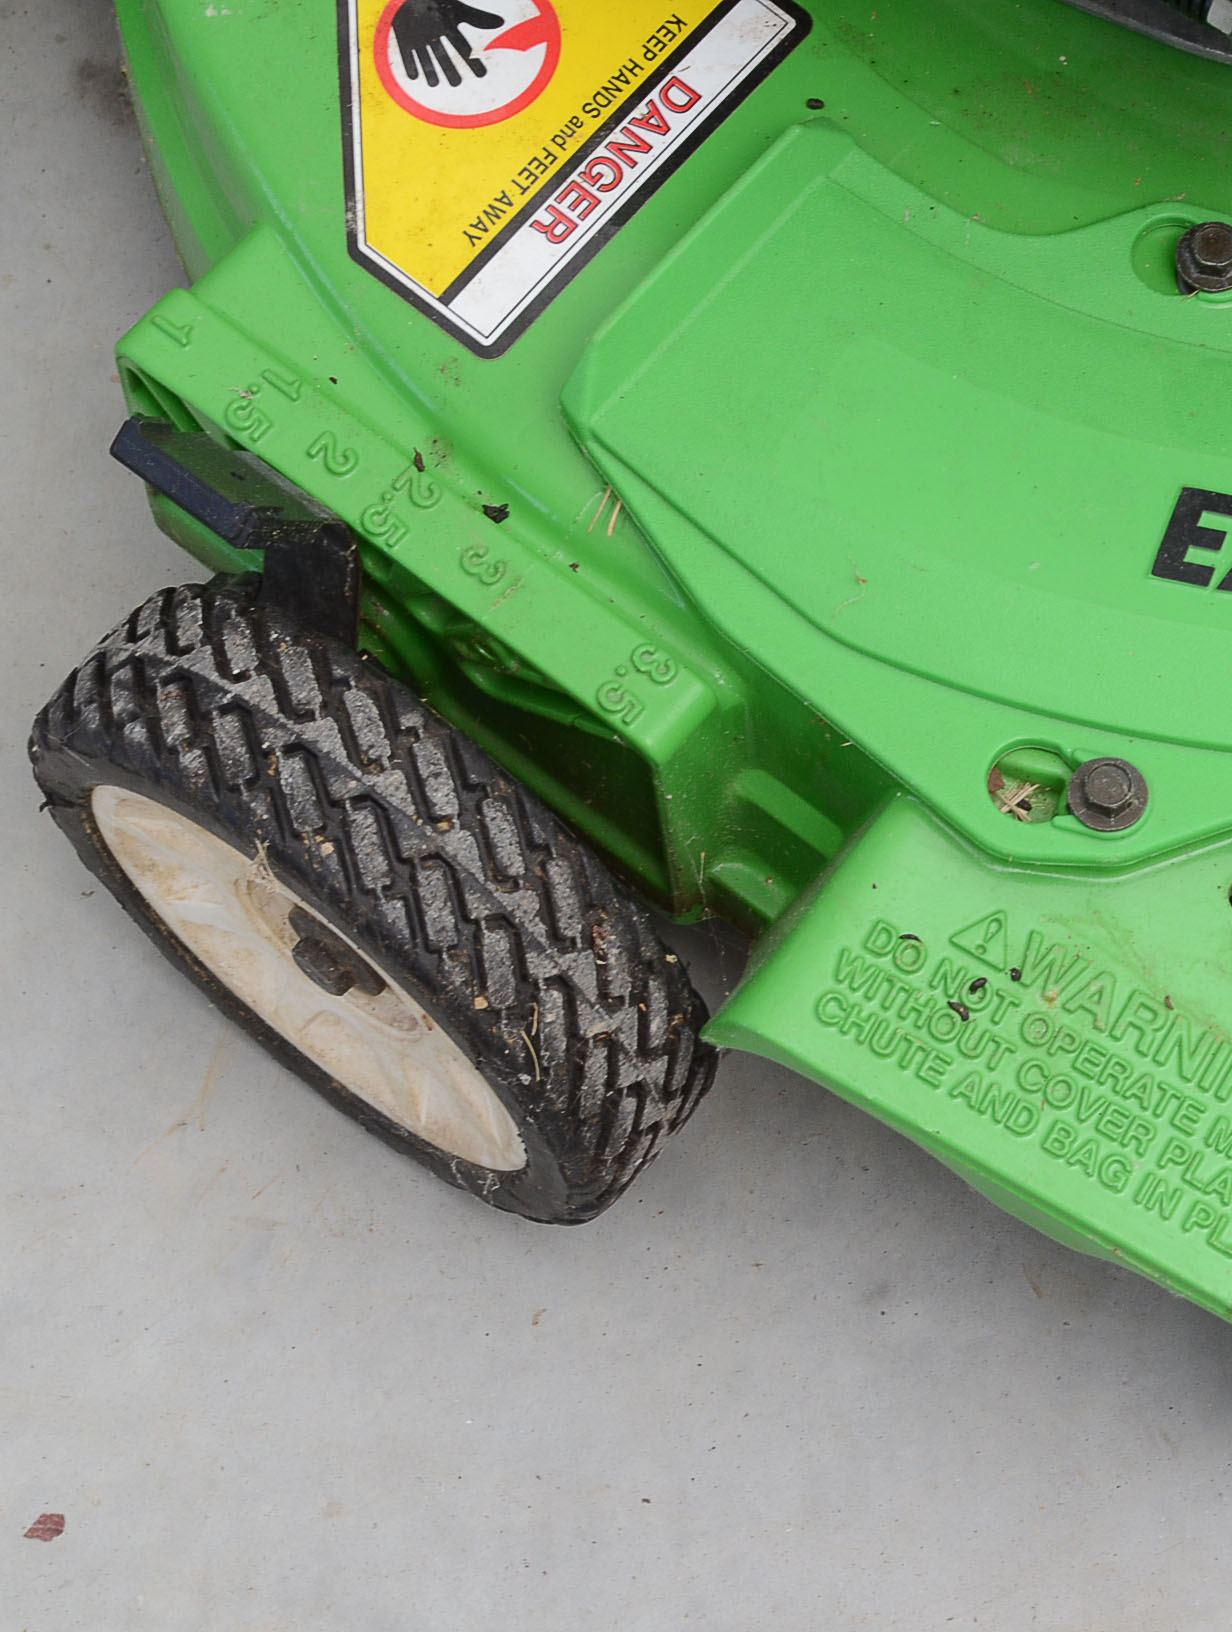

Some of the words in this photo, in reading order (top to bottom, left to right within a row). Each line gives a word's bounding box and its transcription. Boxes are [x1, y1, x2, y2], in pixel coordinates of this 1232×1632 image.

[642, 14, 687, 62] KEEP
[582, 58, 645, 117] HANDS
[529, 76, 702, 244] DANGER
[551, 115, 585, 151] and
[511, 147, 558, 195] FEET
[463, 190, 515, 248] AWAY
[306, 431, 359, 479] 2
[459, 545, 507, 585] 3
[596, 643, 678, 728] 3.5
[834, 948, 1017, 1070] WITHOUT
[1017, 1058, 1157, 1155] COVER
[864, 920, 926, 973] DO
[929, 958, 1021, 1024] NOT
[1021, 1013, 1206, 1136] OPERATE
[815, 992, 953, 1088] CHUTE
[952, 1072, 1039, 1137] AND
[1042, 1120, 1133, 1194] BAG
[1135, 1171, 1179, 1221] IN
